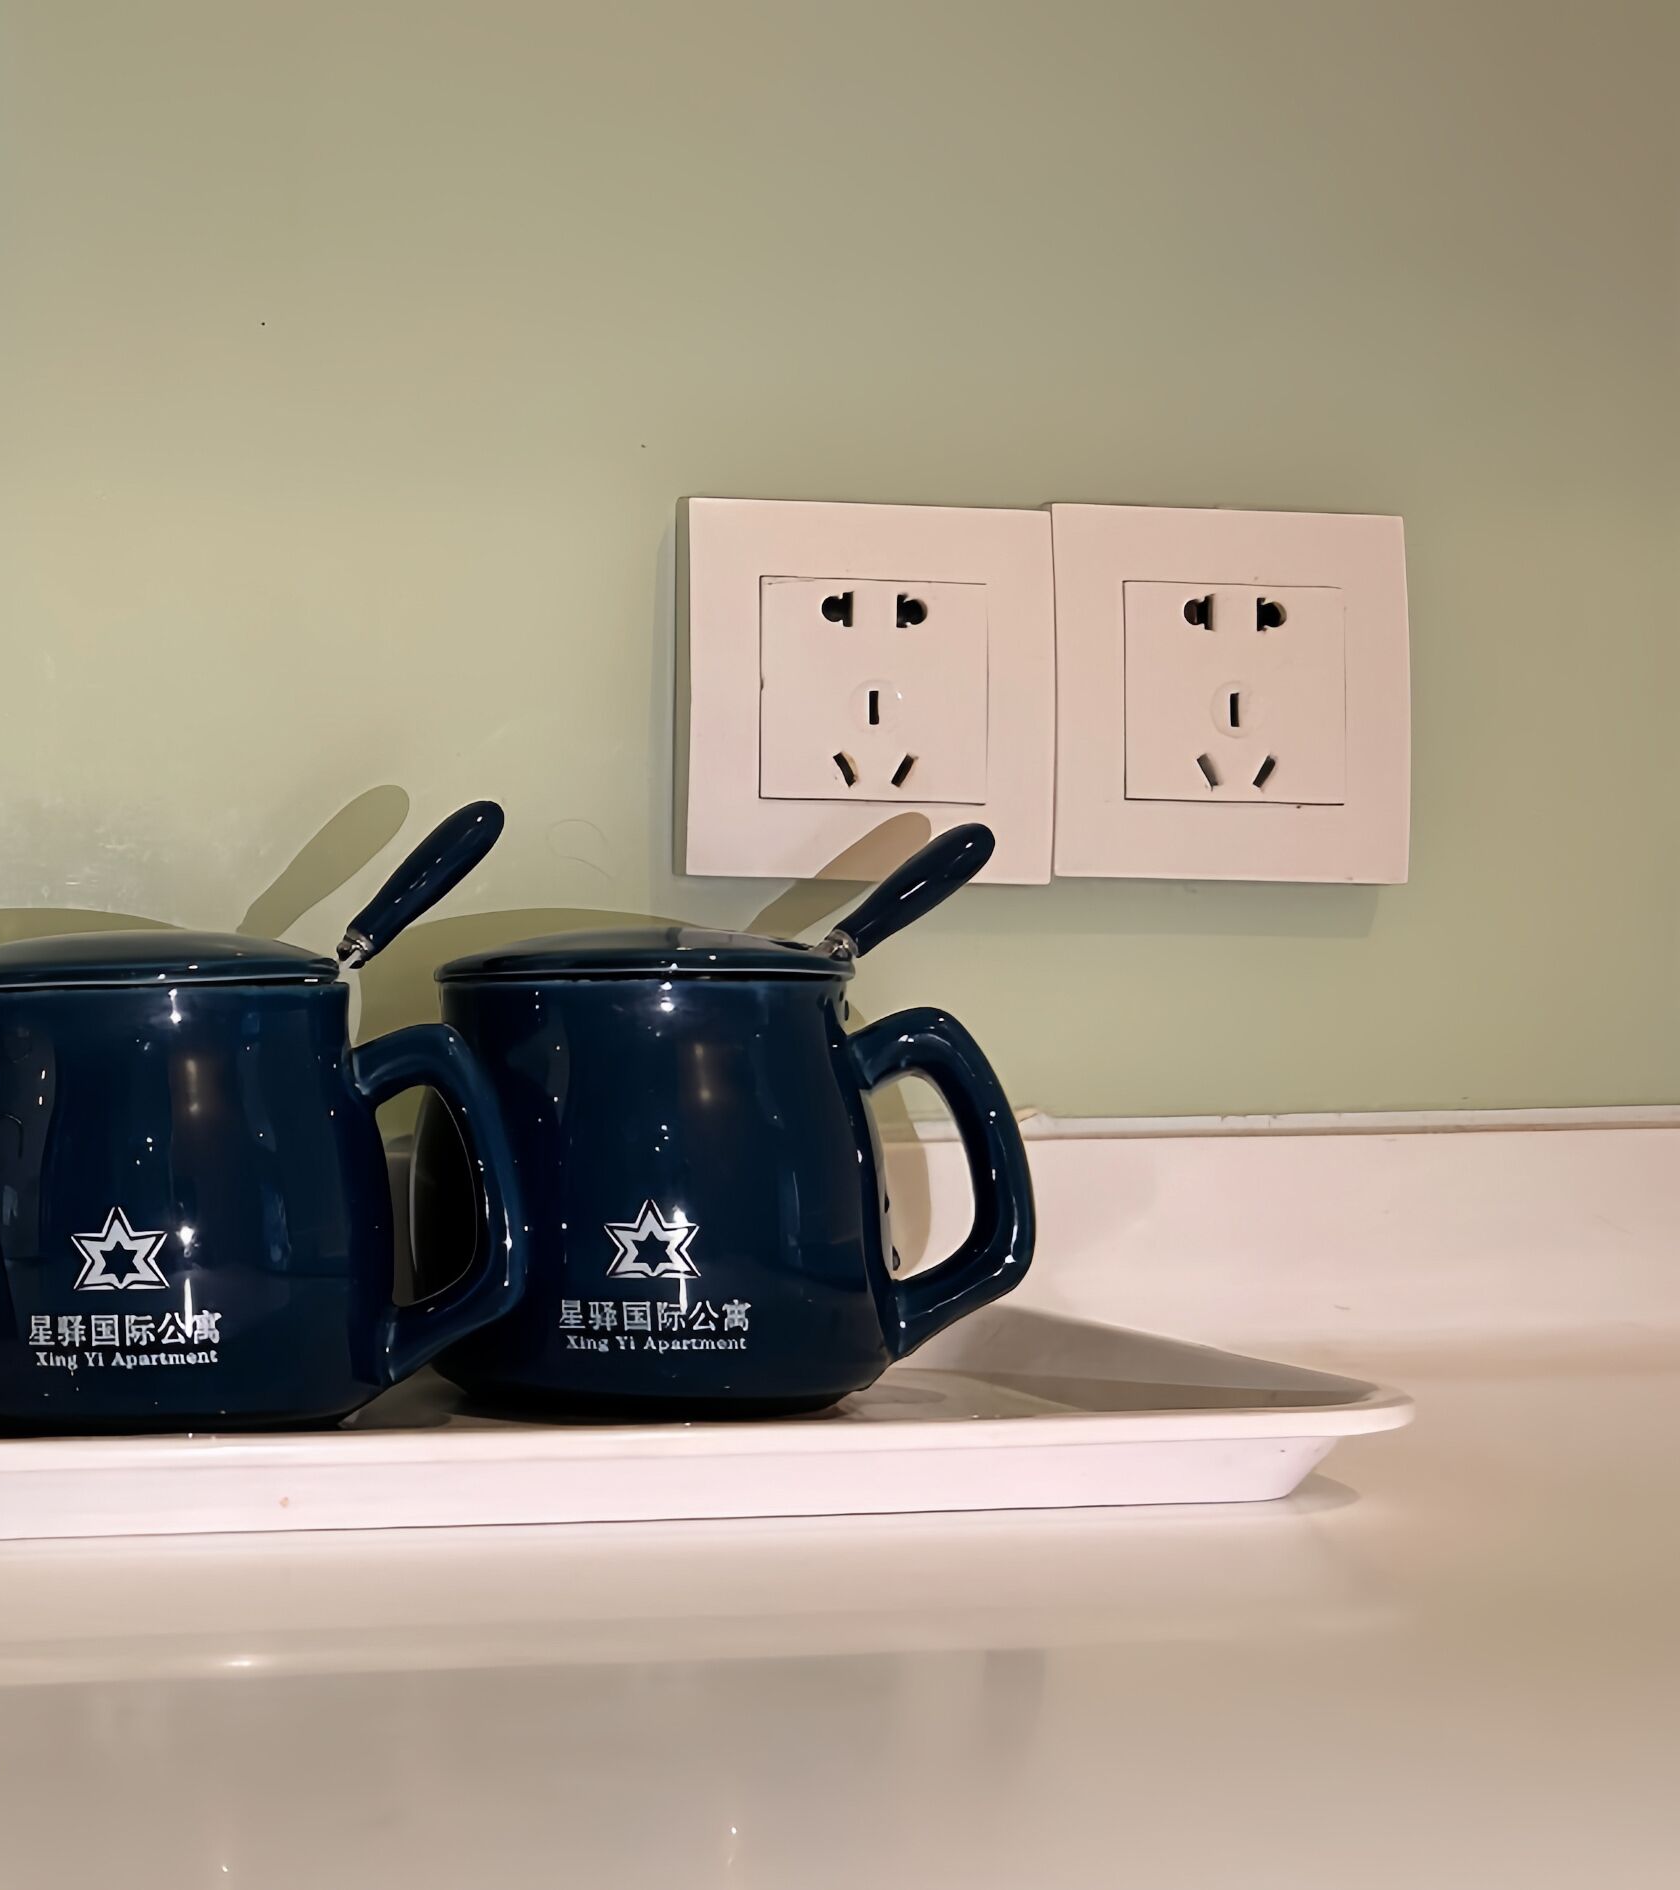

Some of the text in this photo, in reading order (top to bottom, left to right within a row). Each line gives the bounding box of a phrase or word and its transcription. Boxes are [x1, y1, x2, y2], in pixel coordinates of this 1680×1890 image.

[28, 1309, 222, 1347] 星驿国际公寓
[558, 1299, 752, 1332] 星驿国际公寓
[566, 1335, 747, 1354] Xing Yi Apartment
[35, 1349, 218, 1370] Xing Yi Apartment
